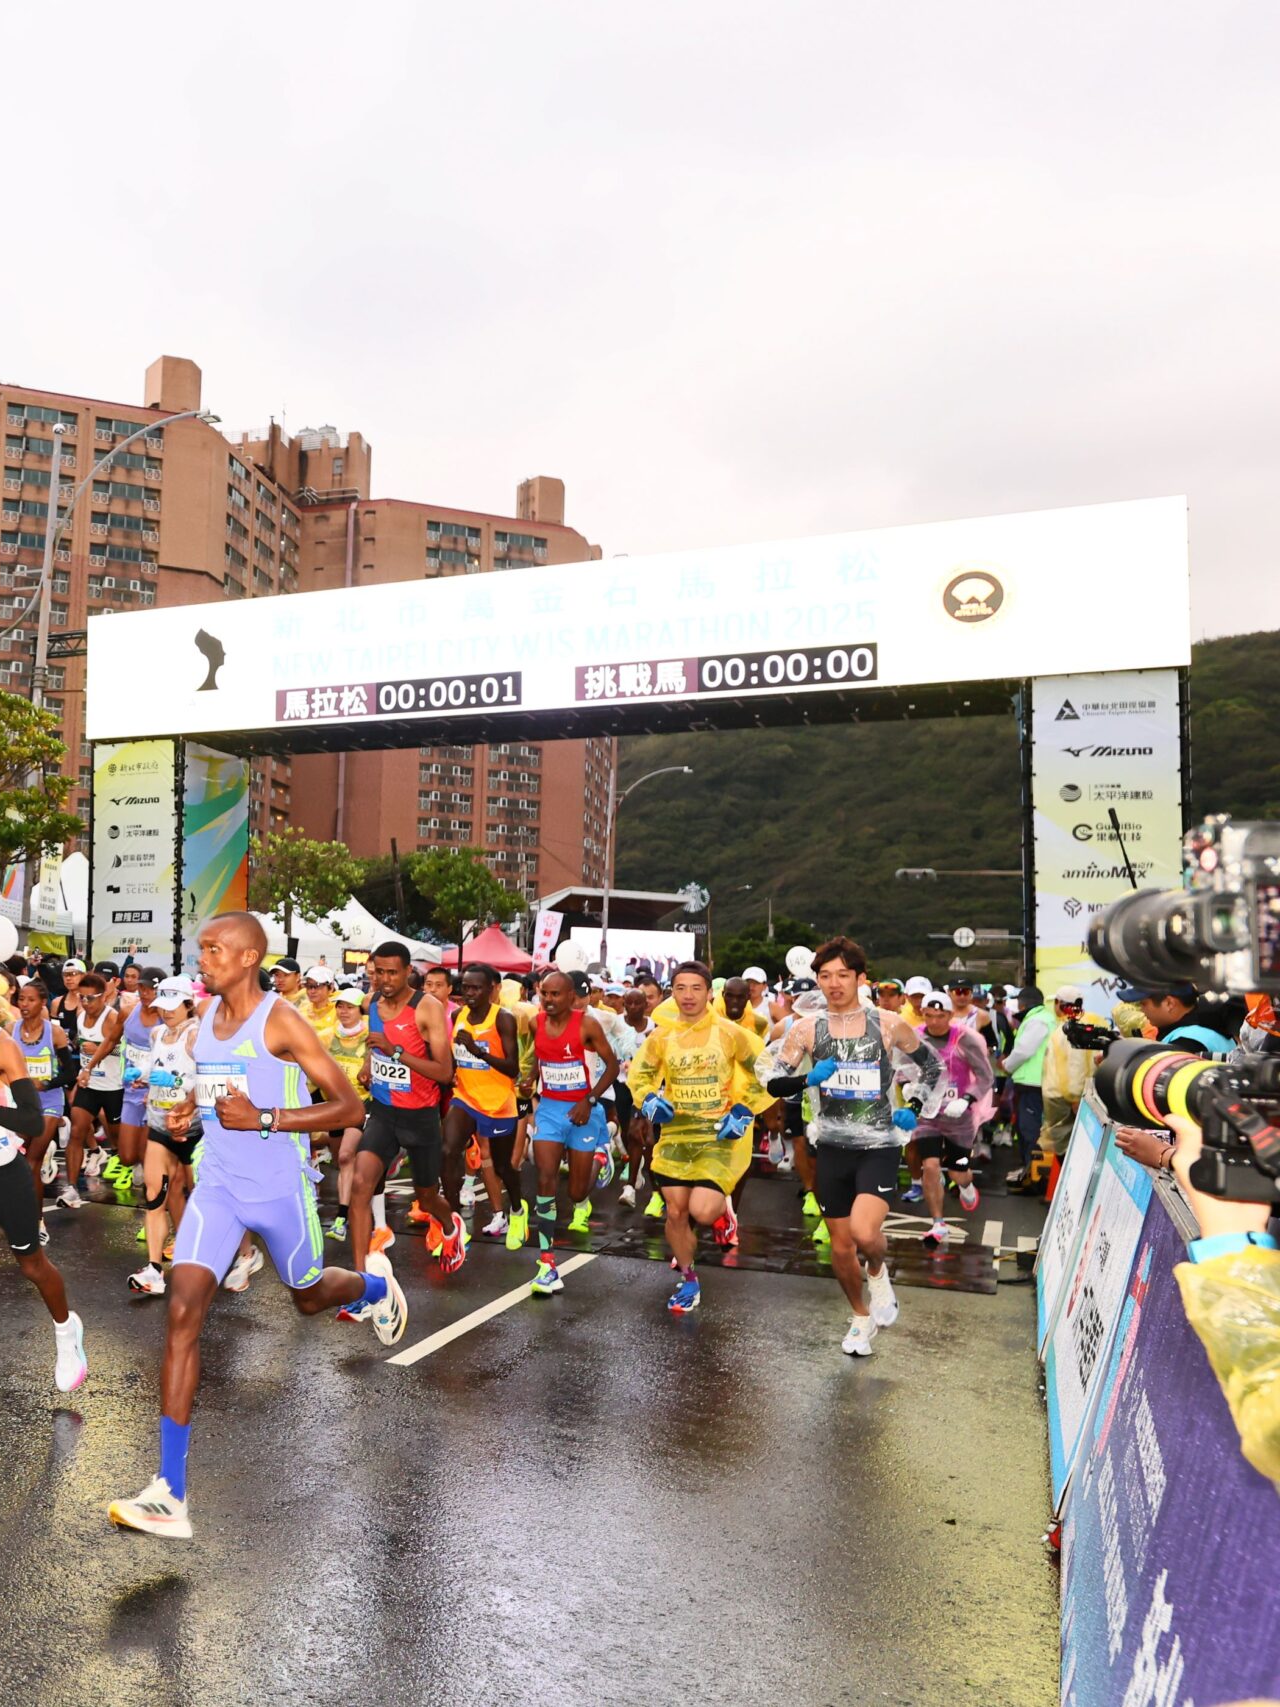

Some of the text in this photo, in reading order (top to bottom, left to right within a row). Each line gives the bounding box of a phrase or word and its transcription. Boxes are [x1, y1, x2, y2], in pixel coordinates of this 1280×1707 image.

[345, 640, 428, 675] TAIPEI
[438, 634, 500, 667] CITY
[586, 610, 773, 657] MARATHON
[784, 600, 881, 640] 2025
[583, 661, 687, 700] 挑戰馬
[701, 647, 874, 688] 00:00:00
[282, 684, 369, 720] 馬拉松
[378, 676, 518, 711] 00:00:01
[1096, 823, 1142, 831] GuiBio
[545, 1070, 580, 1081] SHUMAY
[674, 1087, 717, 1099] CHANG
[838, 1074, 860, 1086] LIN
